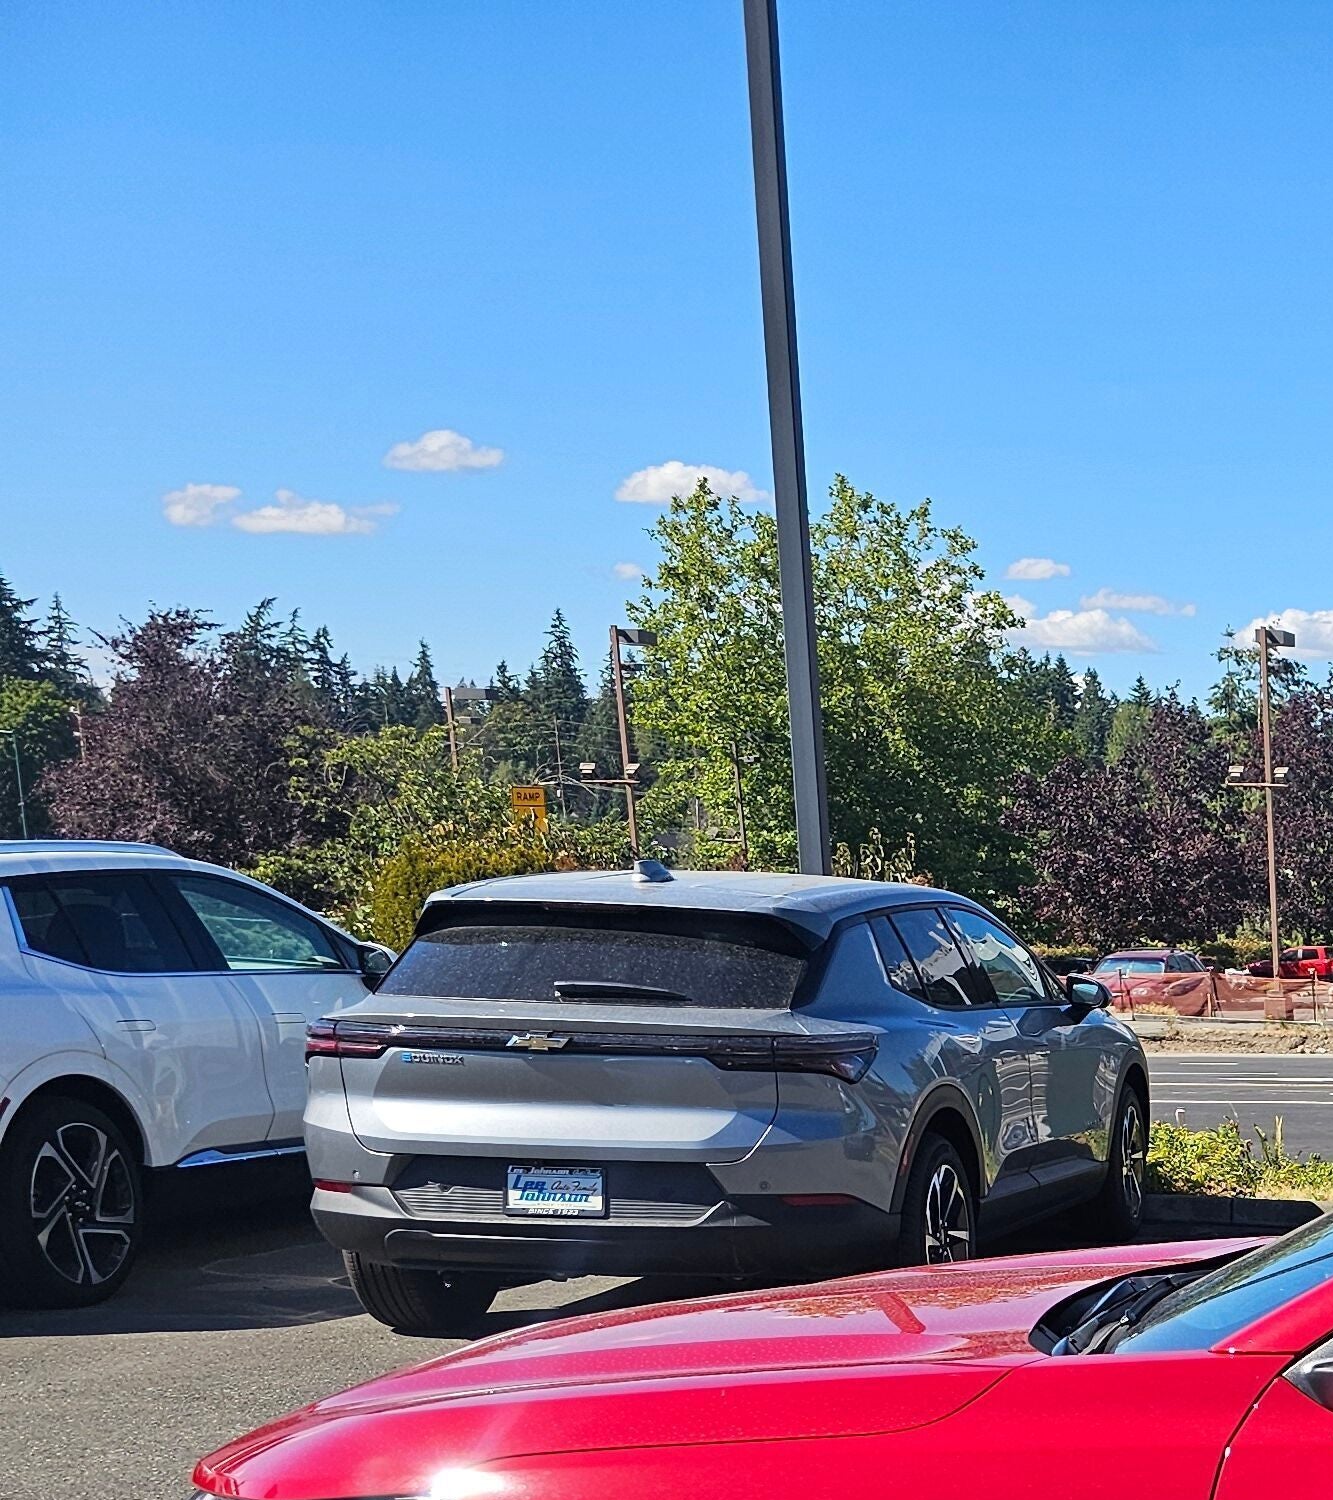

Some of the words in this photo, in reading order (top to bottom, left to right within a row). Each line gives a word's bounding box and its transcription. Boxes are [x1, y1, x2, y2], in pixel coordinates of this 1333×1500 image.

[516, 791, 541, 801] RAMP
[401, 1052, 465, 1064] EQUINOX
[512, 1174, 547, 1191] Lee
